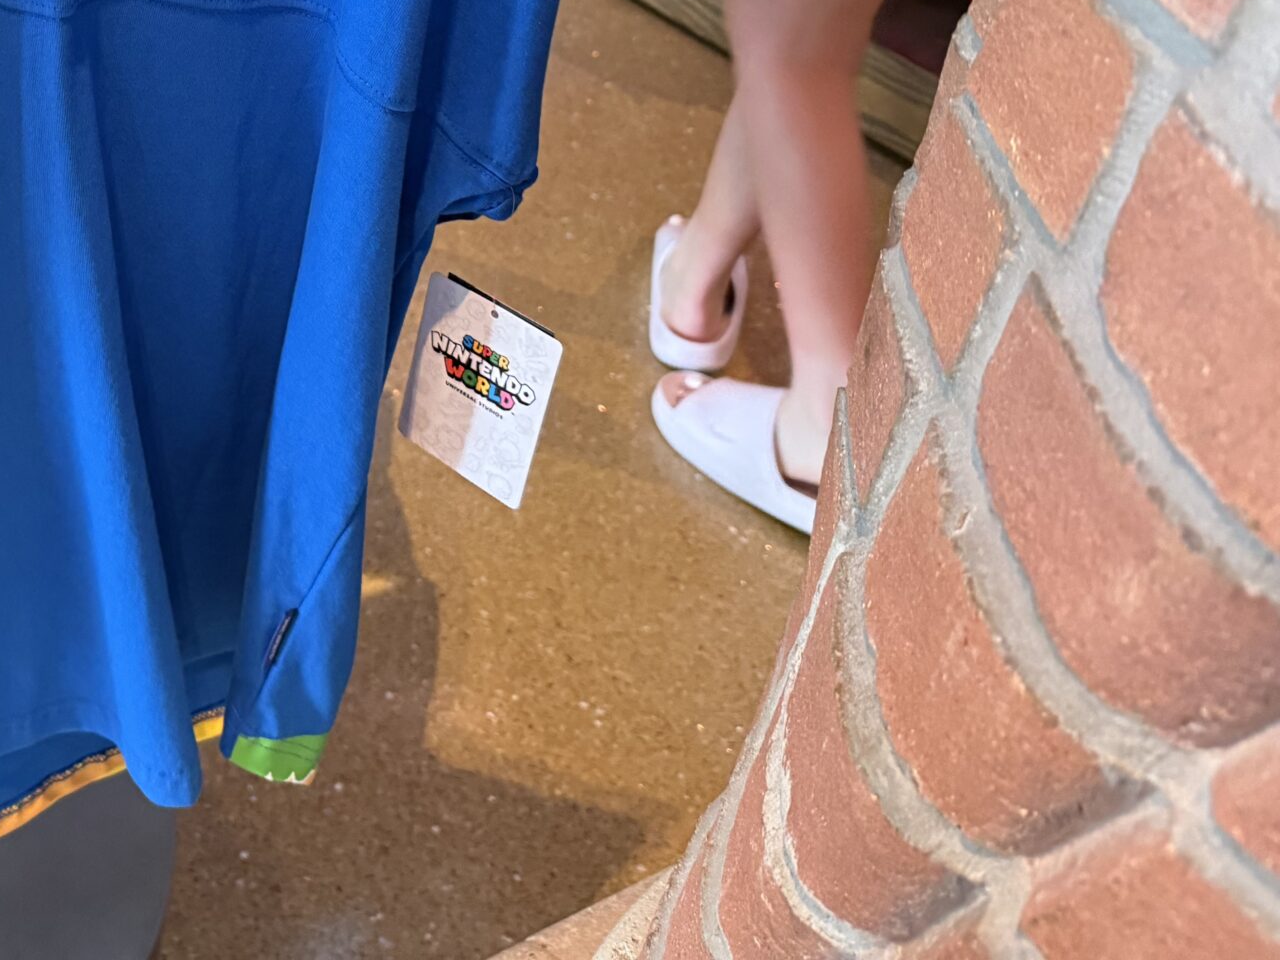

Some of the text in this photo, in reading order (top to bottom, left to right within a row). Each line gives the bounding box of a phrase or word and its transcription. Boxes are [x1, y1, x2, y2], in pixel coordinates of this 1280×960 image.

[431, 331, 536, 406] NINTENDO
[462, 334, 510, 371] SUPER
[444, 356, 516, 411] WORLD
